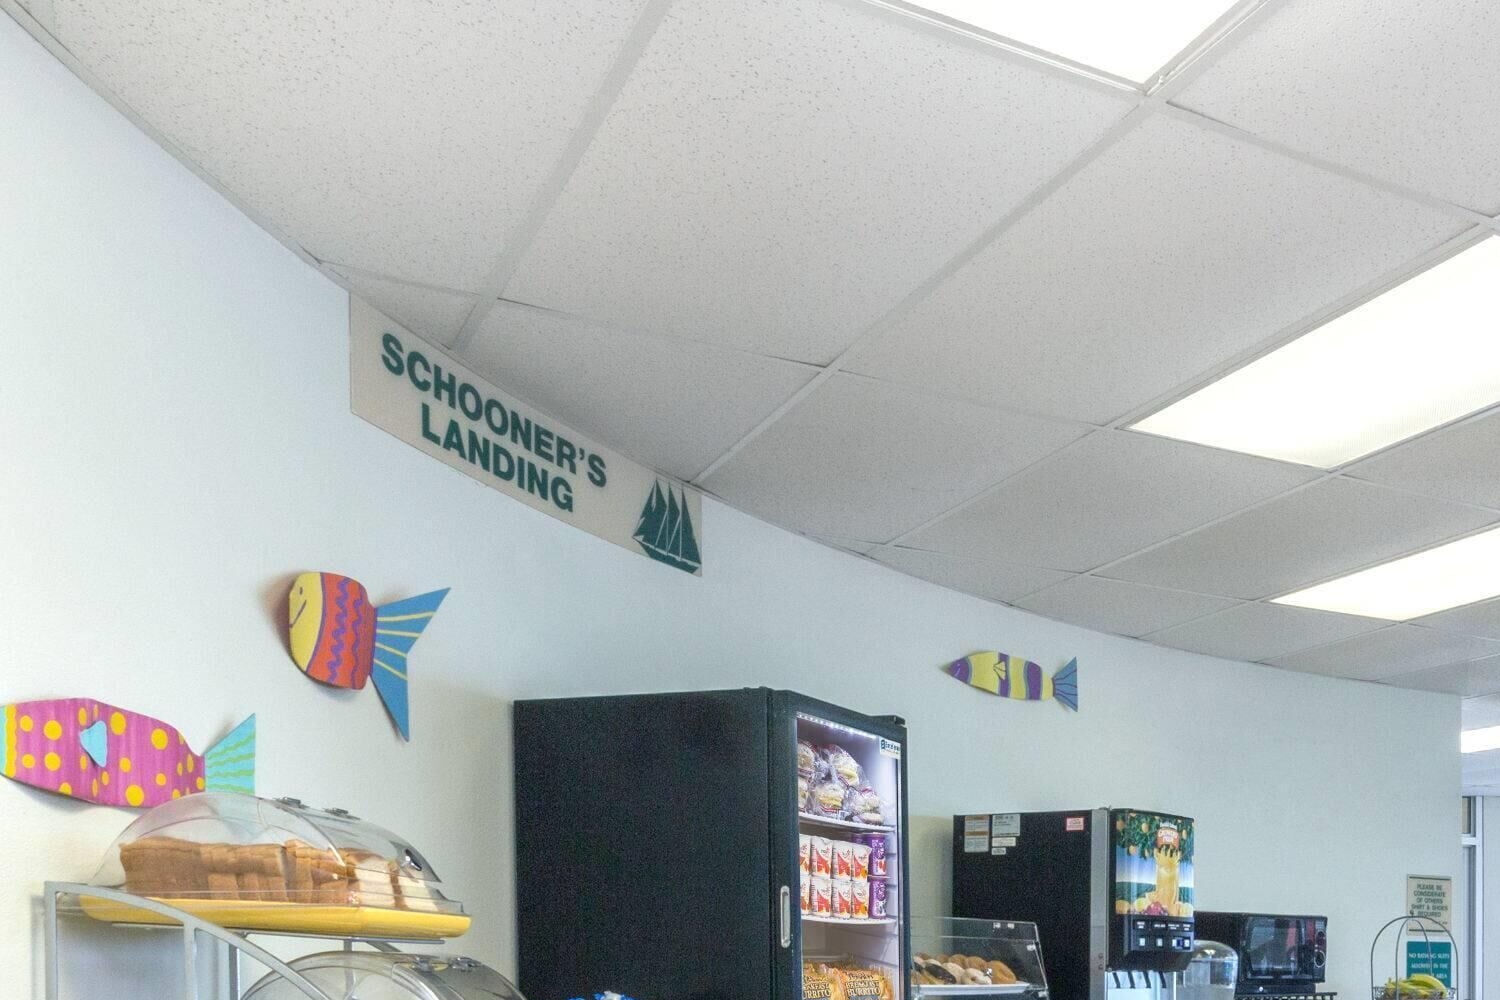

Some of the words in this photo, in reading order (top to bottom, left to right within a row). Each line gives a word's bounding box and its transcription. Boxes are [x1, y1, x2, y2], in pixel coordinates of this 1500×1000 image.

[381, 333, 607, 488] SCHOONER'S
[421, 402, 574, 513] LANDING
[803, 989, 830, 999] URRITO
